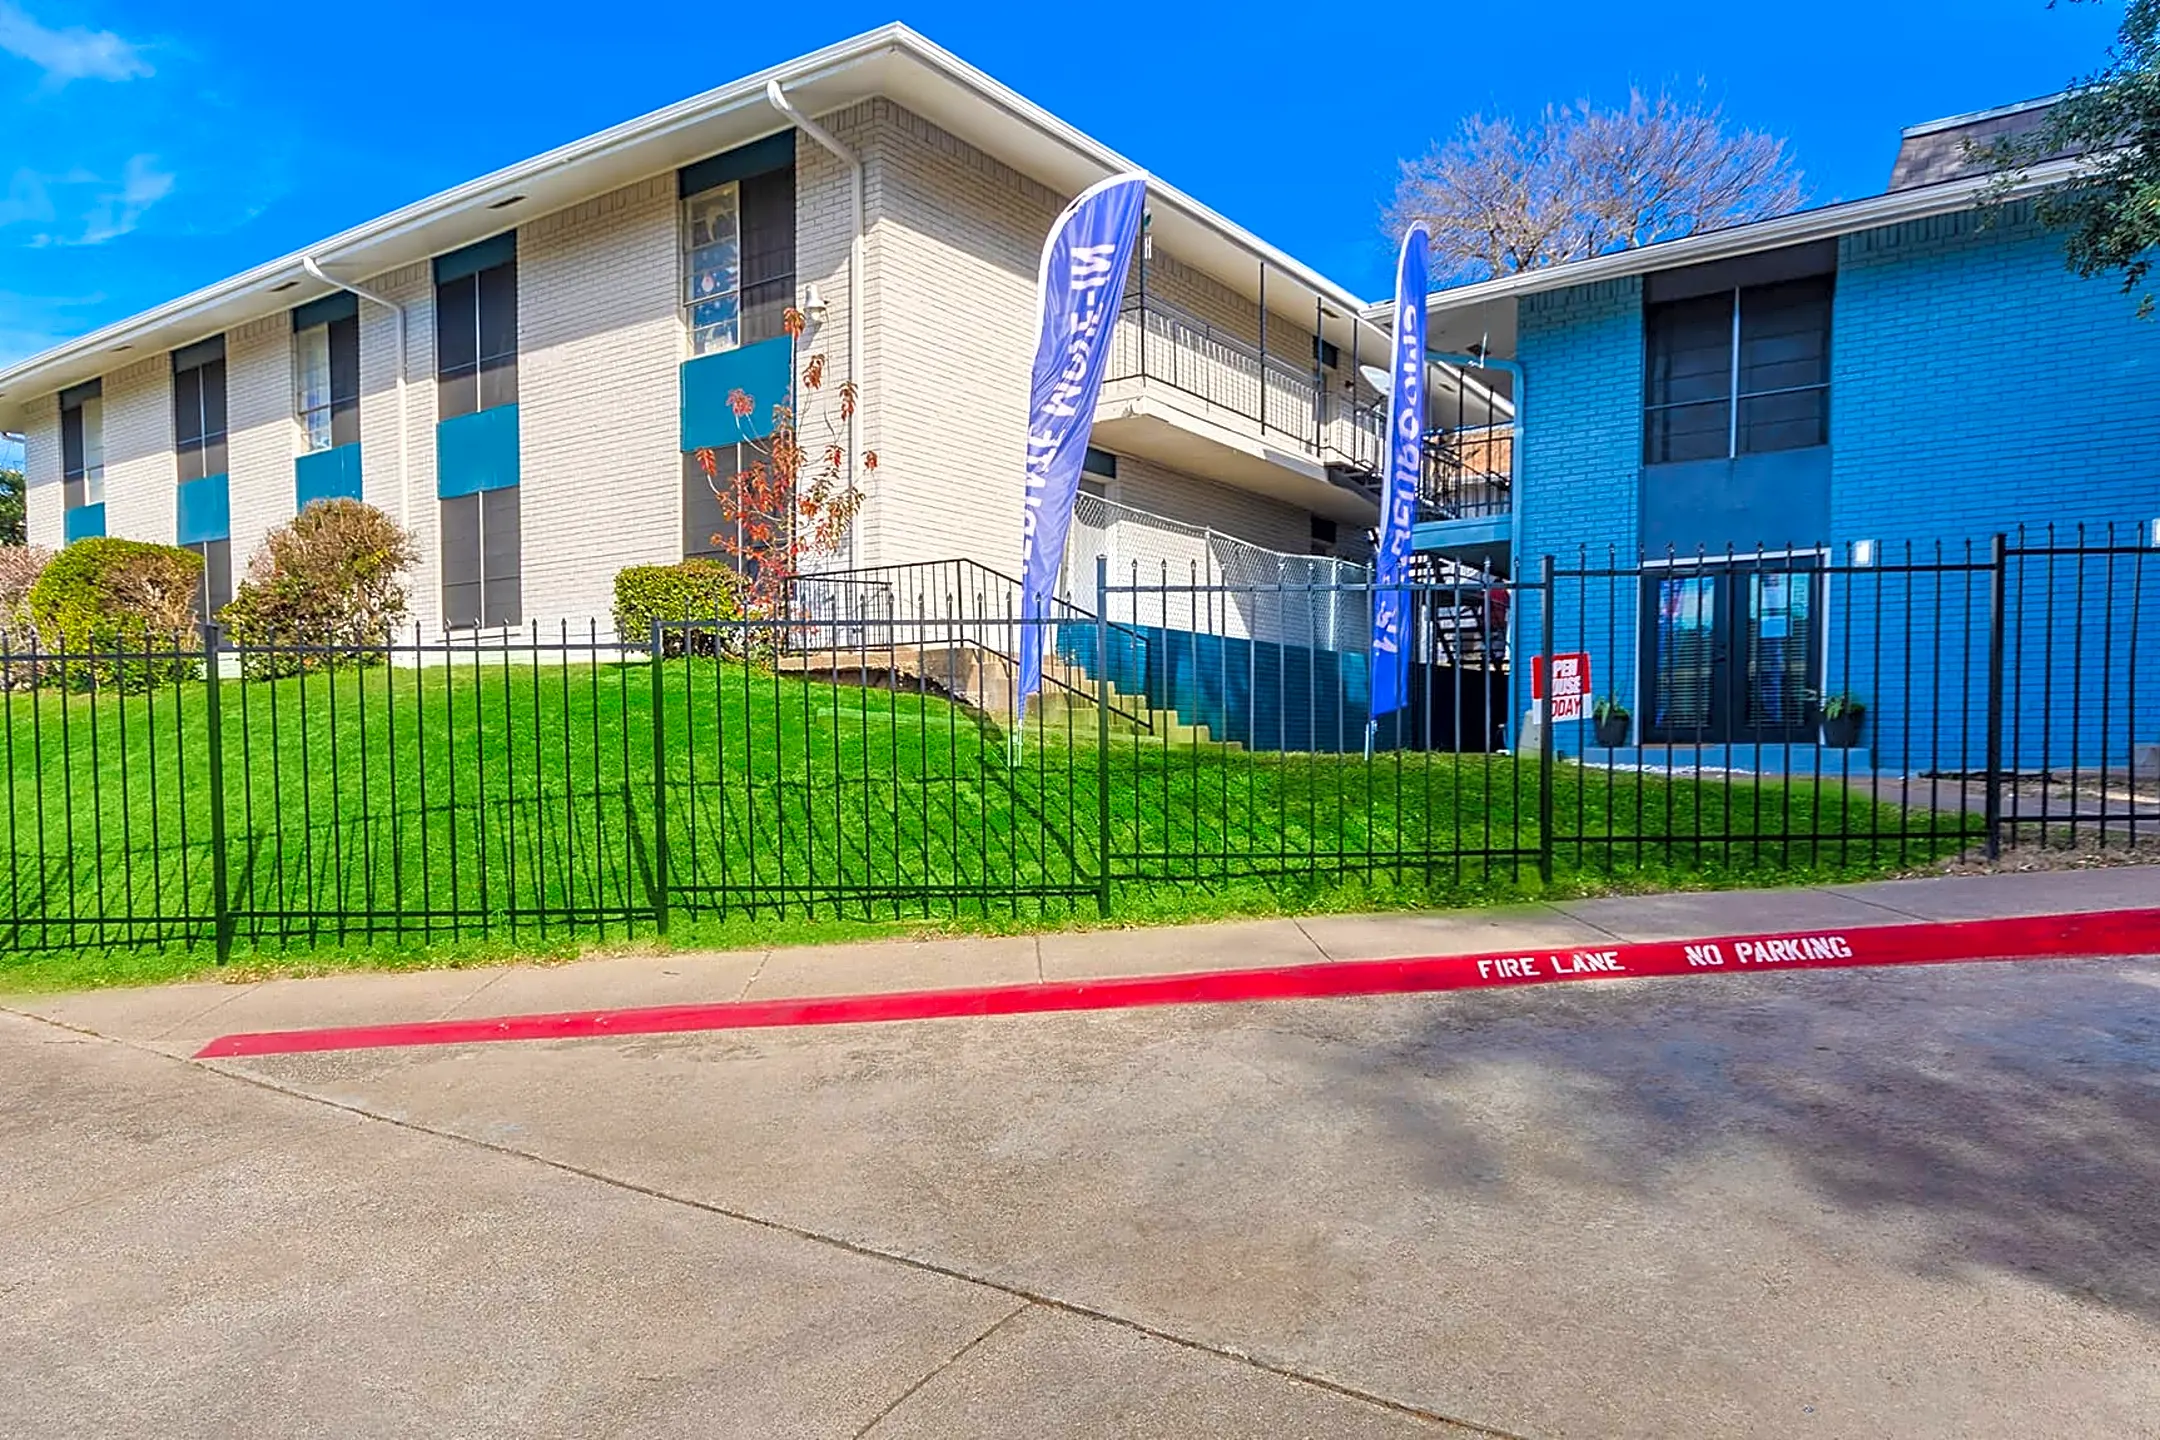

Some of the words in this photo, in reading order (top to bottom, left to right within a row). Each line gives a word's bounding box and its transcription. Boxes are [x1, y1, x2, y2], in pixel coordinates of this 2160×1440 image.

[1551, 698, 1580, 716] ODAY
[1477, 957, 1541, 979] FIRE
[1550, 951, 1626, 974] LANE
[1684, 944, 1724, 966] NO
[1734, 936, 1853, 963] PARKING
